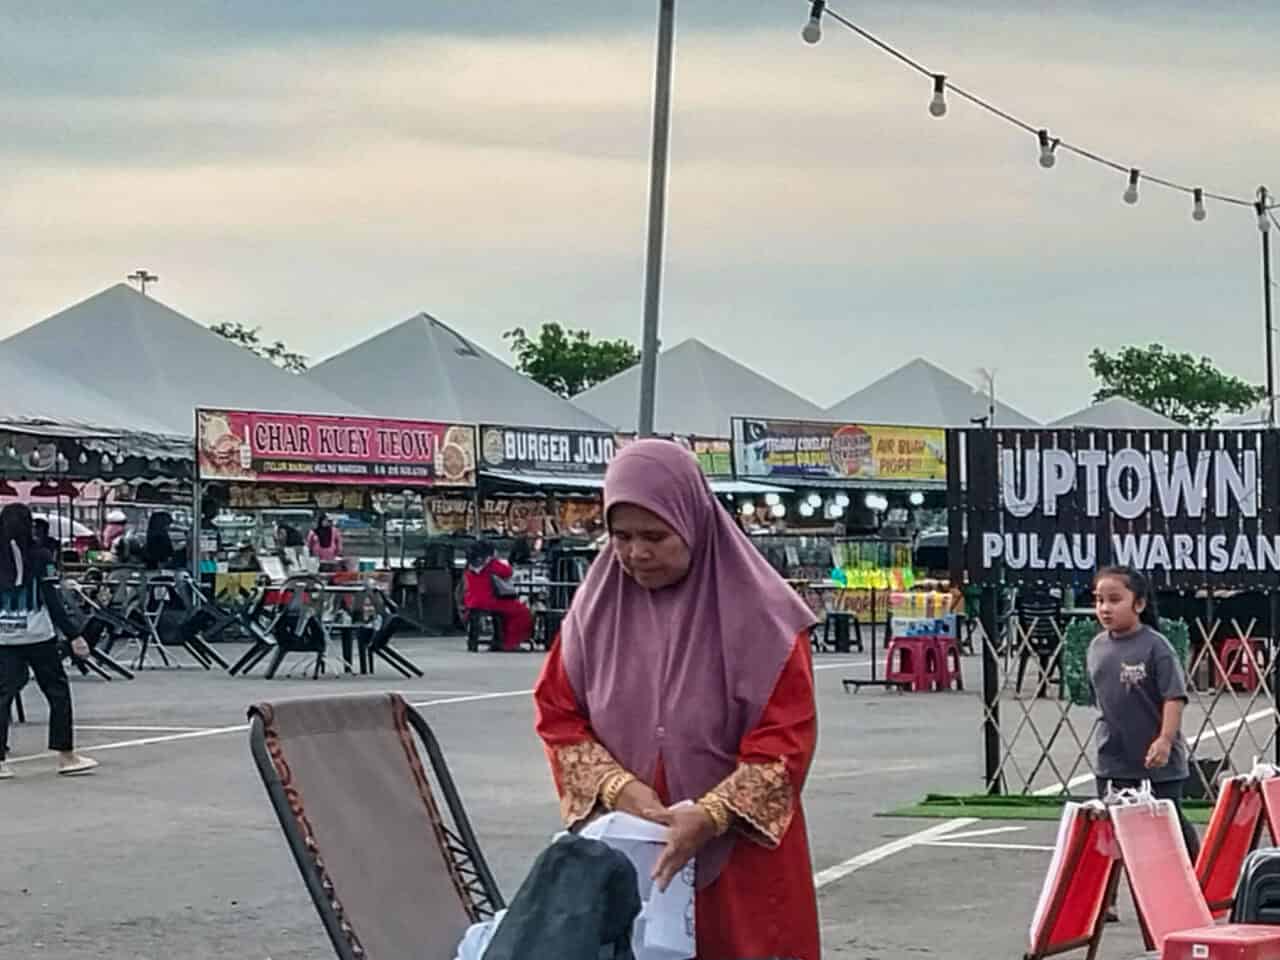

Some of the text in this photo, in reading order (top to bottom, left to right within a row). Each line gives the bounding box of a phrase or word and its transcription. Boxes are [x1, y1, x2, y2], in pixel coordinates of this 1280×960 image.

[255, 422, 433, 458] CHAR KUEY TEOW
[504, 431, 615, 464] BURGER JOJO
[1000, 448, 1259, 519] UPTOWN
[981, 532, 1097, 569] PULAU
